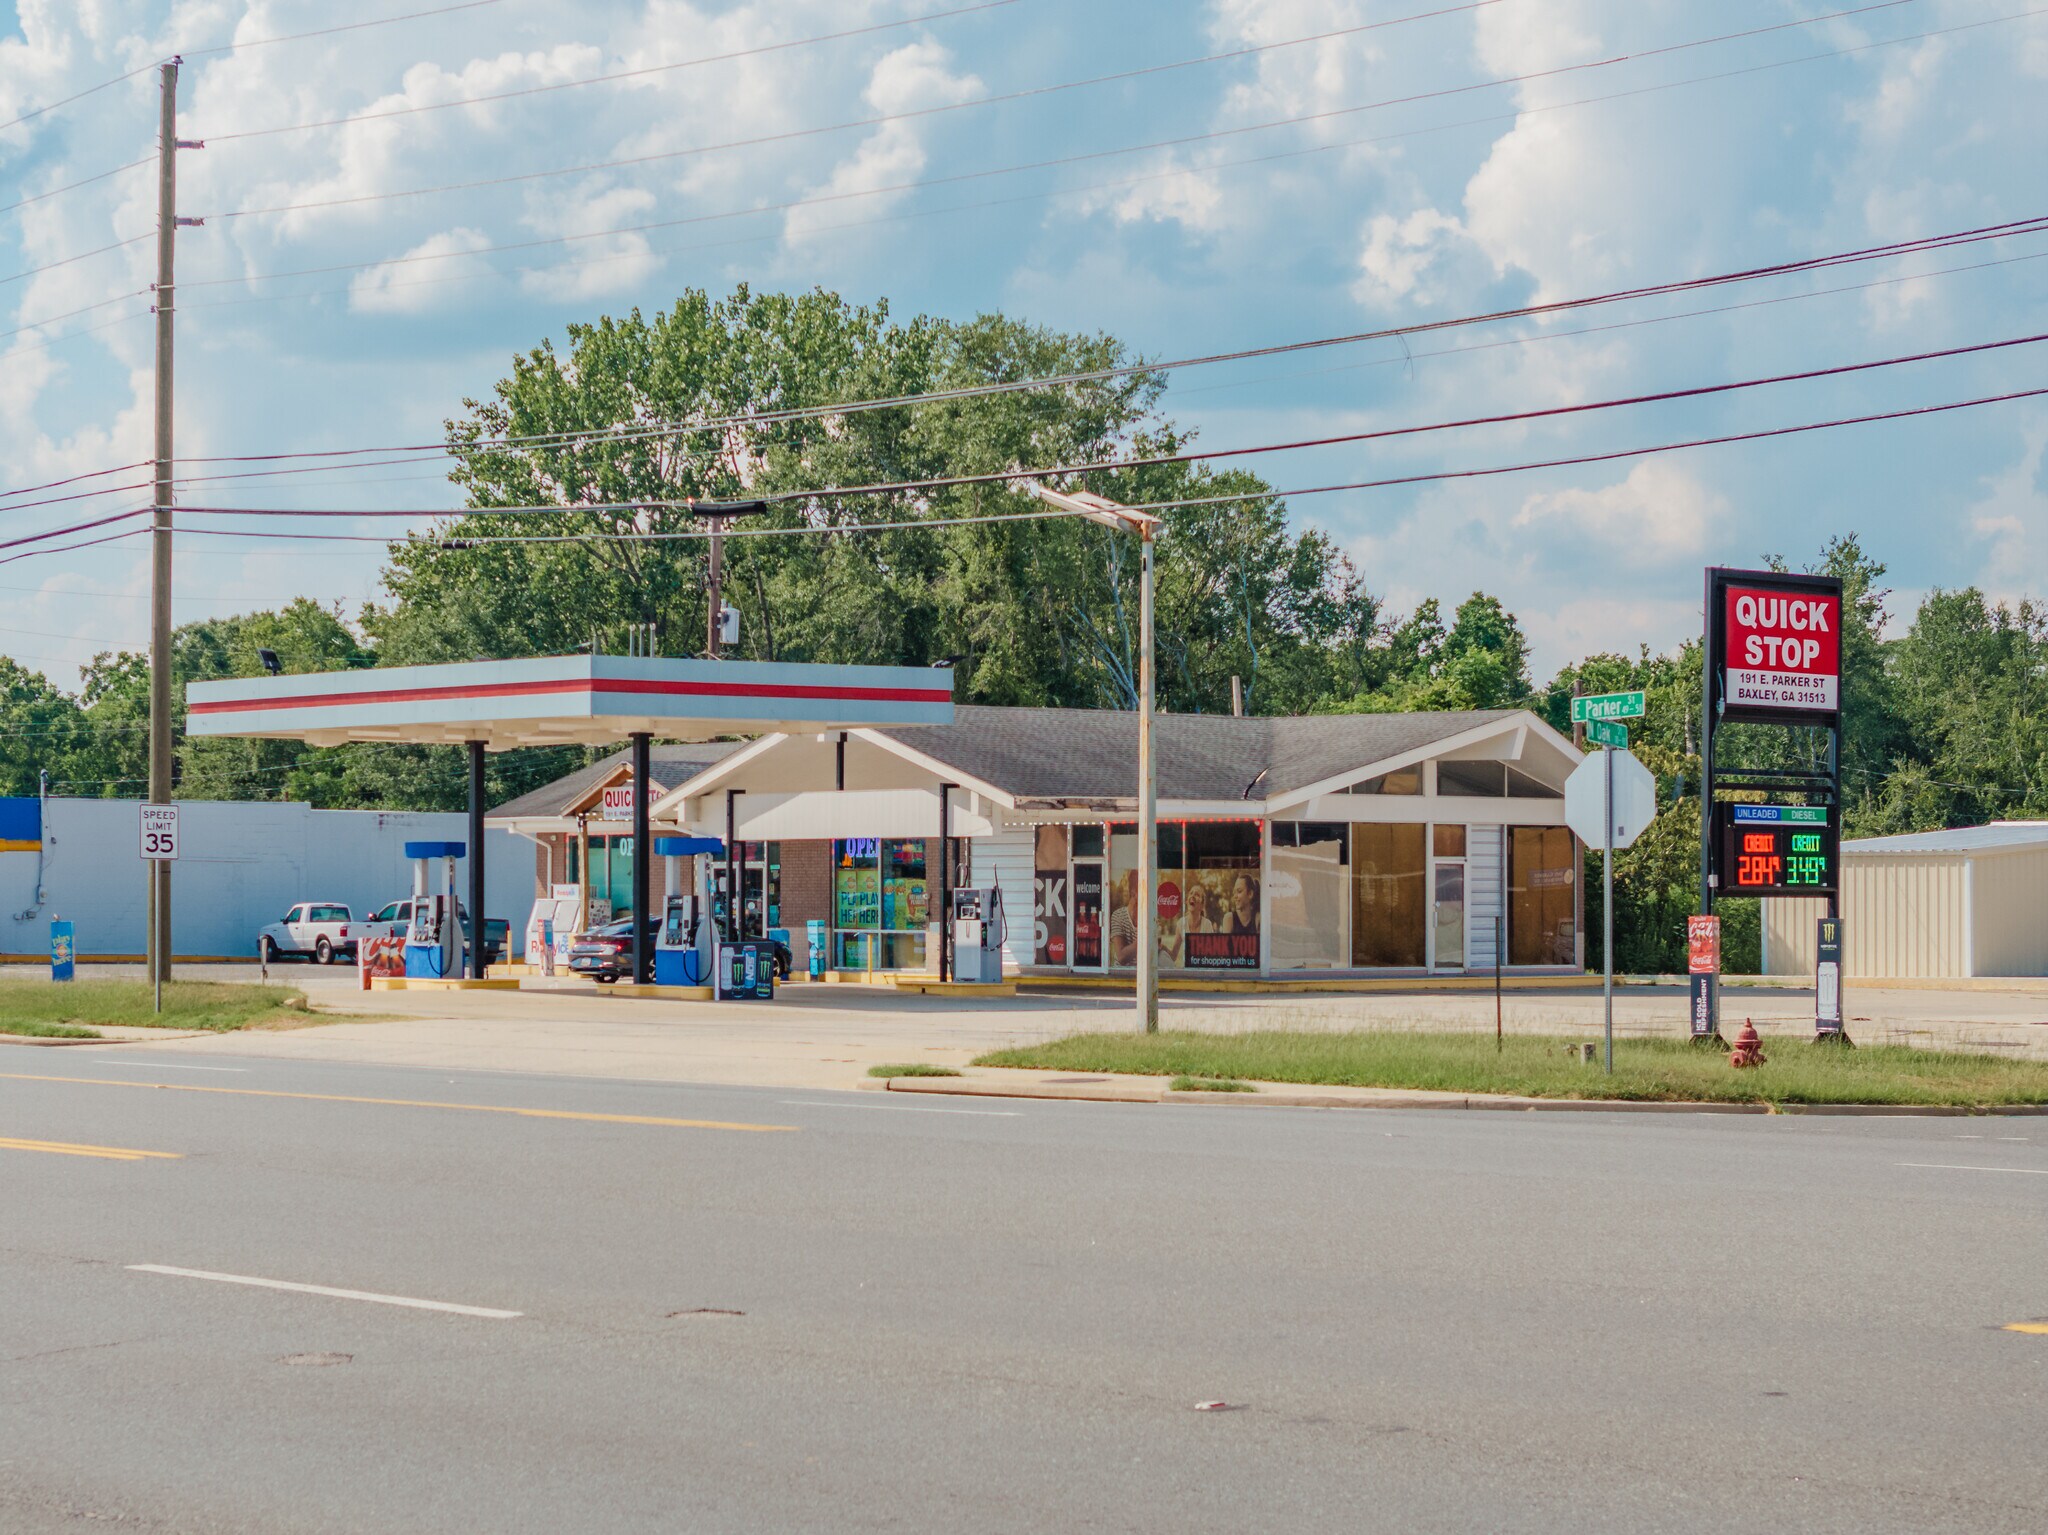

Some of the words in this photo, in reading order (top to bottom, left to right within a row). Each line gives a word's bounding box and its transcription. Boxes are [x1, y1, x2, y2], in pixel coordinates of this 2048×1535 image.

[1736, 596, 1829, 632] QUICK
[1745, 635, 1820, 669] STOP
[1740, 673, 1757, 684] 191
[1760, 675, 1769, 685] E.
[1772, 675, 1810, 687] PARKER
[1813, 678, 1825, 688] ST
[1738, 688, 1779, 703] BAXLEY,
[1781, 691, 1795, 701] GA
[1798, 692, 1826, 703] 31513
[1574, 701, 1581, 719] E
[1586, 699, 1622, 717] Parker
[1588, 719, 1595, 738] N
[1597, 723, 1611, 742] Oak
[605, 790, 634, 808] QUIC
[143, 811, 176, 820] SPEED
[1737, 809, 1778, 819] UNLEADED
[1791, 810, 1818, 820] DIESEL
[146, 822, 172, 831] LIMIT
[145, 833, 174, 853] 35
[1792, 834, 1820, 852] CREDIT
[1076, 881, 1101, 894] welcome
[1189, 935, 1230, 956] THANK
[1231, 935, 1257, 956] YOU
[1190, 956, 1200, 965] for
[1201, 956, 1231, 967] shopping
[1232, 956, 1246, 965] with
[1247, 958, 1255, 966] us
